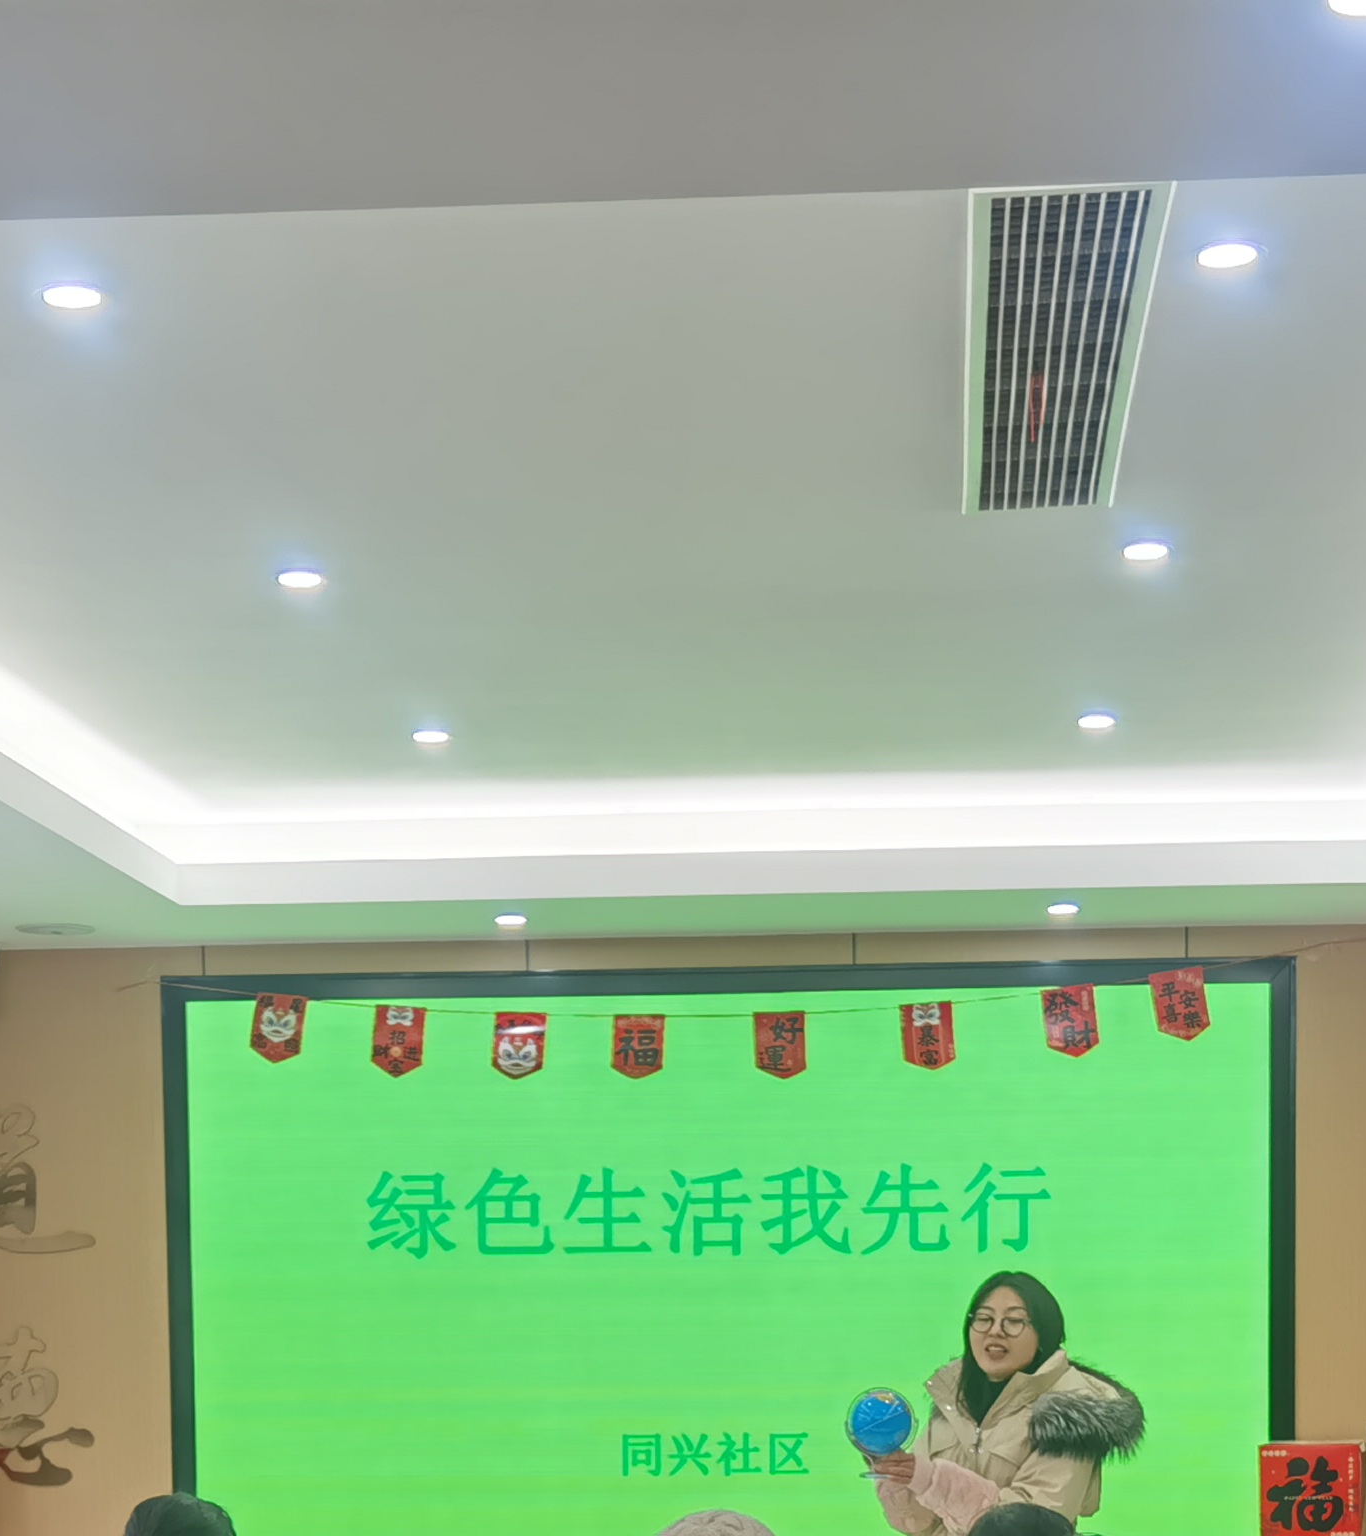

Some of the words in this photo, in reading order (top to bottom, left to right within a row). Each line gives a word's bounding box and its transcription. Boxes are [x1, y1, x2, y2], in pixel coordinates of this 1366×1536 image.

[614, 1028, 660, 1068] 福
[757, 1016, 804, 1073] 好運
[366, 1163, 1051, 1259] 绿色生活我先行
[620, 1431, 810, 1477] 同兴社区
[1266, 1455, 1344, 1533] 福
